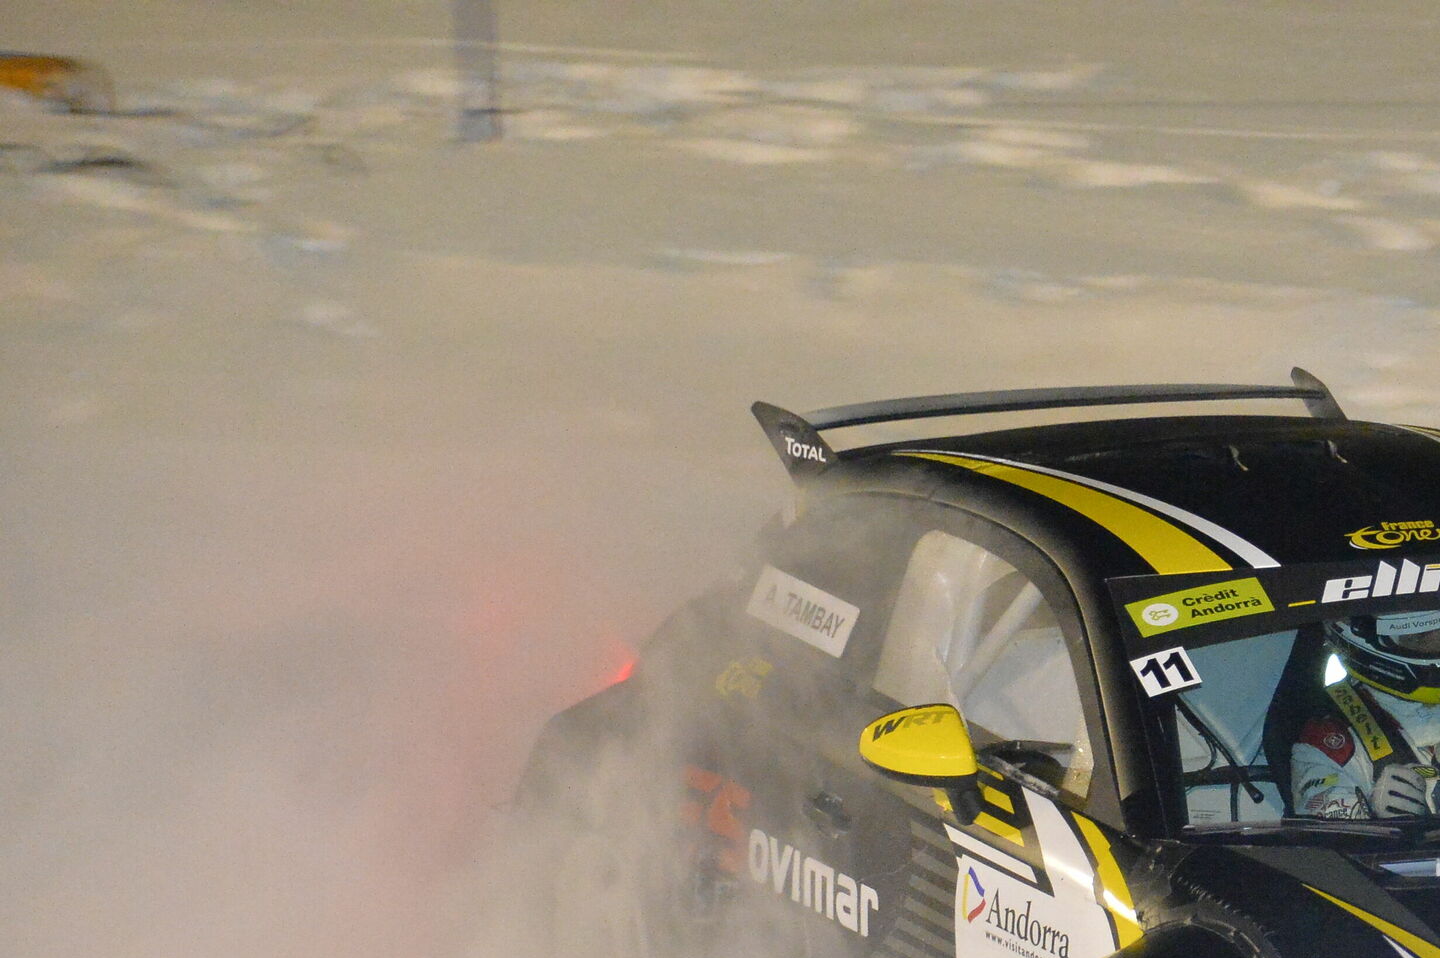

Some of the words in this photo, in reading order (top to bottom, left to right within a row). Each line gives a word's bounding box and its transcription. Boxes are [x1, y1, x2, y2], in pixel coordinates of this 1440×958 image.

[784, 436, 827, 463] TOTAL
[1382, 519, 1435, 532] France
[1182, 588, 1239, 607] Crèdit
[1191, 597, 1263, 619] Andorrà
[783, 592, 846, 639] TAMBAY
[1389, 622, 1411, 631] Audi
[1139, 651, 1194, 689] 11
[872, 710, 955, 742] WRT
